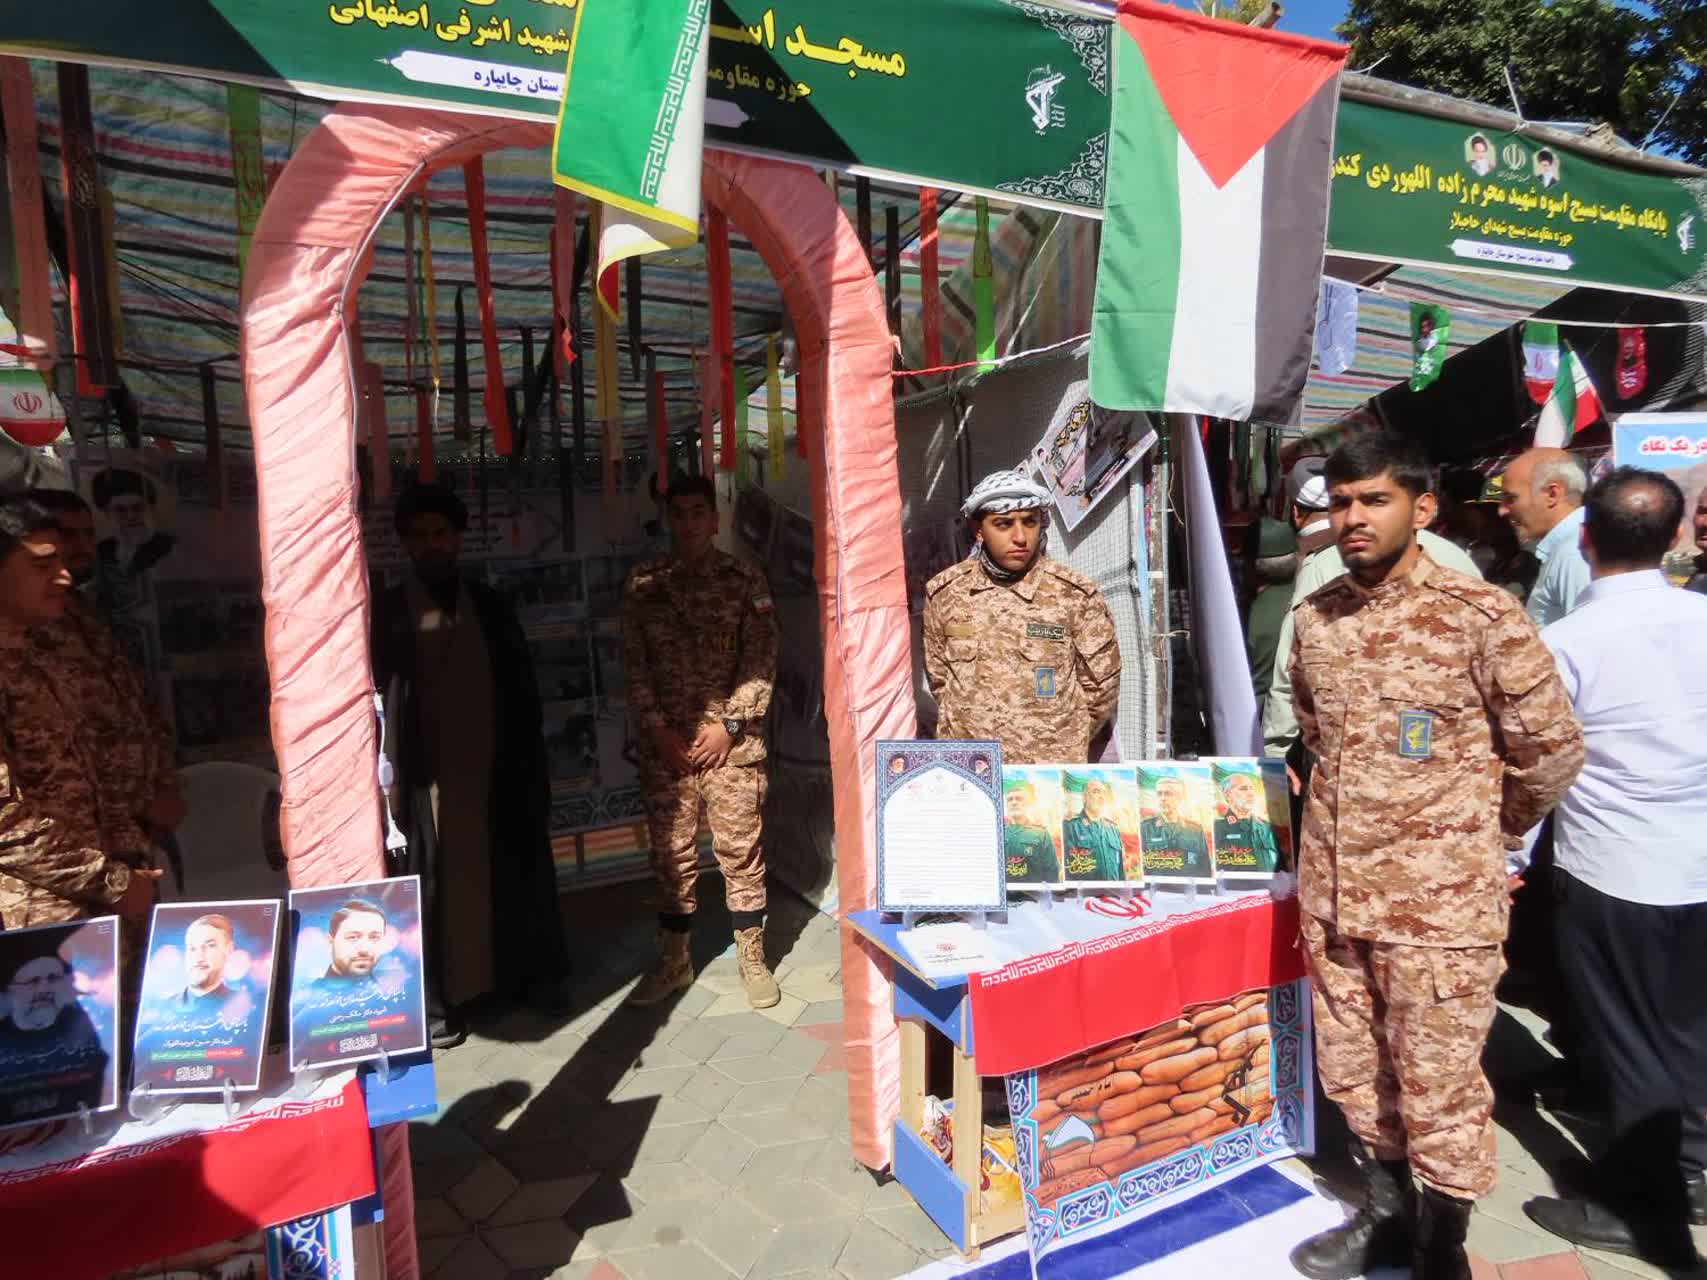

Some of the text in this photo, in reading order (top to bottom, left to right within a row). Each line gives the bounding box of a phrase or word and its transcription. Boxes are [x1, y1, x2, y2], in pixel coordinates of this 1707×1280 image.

[329, 0, 811, 101] حوزه مقاوم شهید اشرفی اصفهانی
[785, 24, 906, 78] مسجد
[527, 77, 564, 96] ستان
[1508, 187, 1538, 212] شهید
[1569, 199, 1600, 224] بسیج
[1600, 203, 1636, 229] مقاومت
[1637, 207, 1669, 238] پایگاه
[1508, 224, 1527, 239] بسیج
[1527, 226, 1553, 243] مقاومت
[1554, 232, 1574, 247] حوزه
[1642, 438, 1666, 452] نگاه
